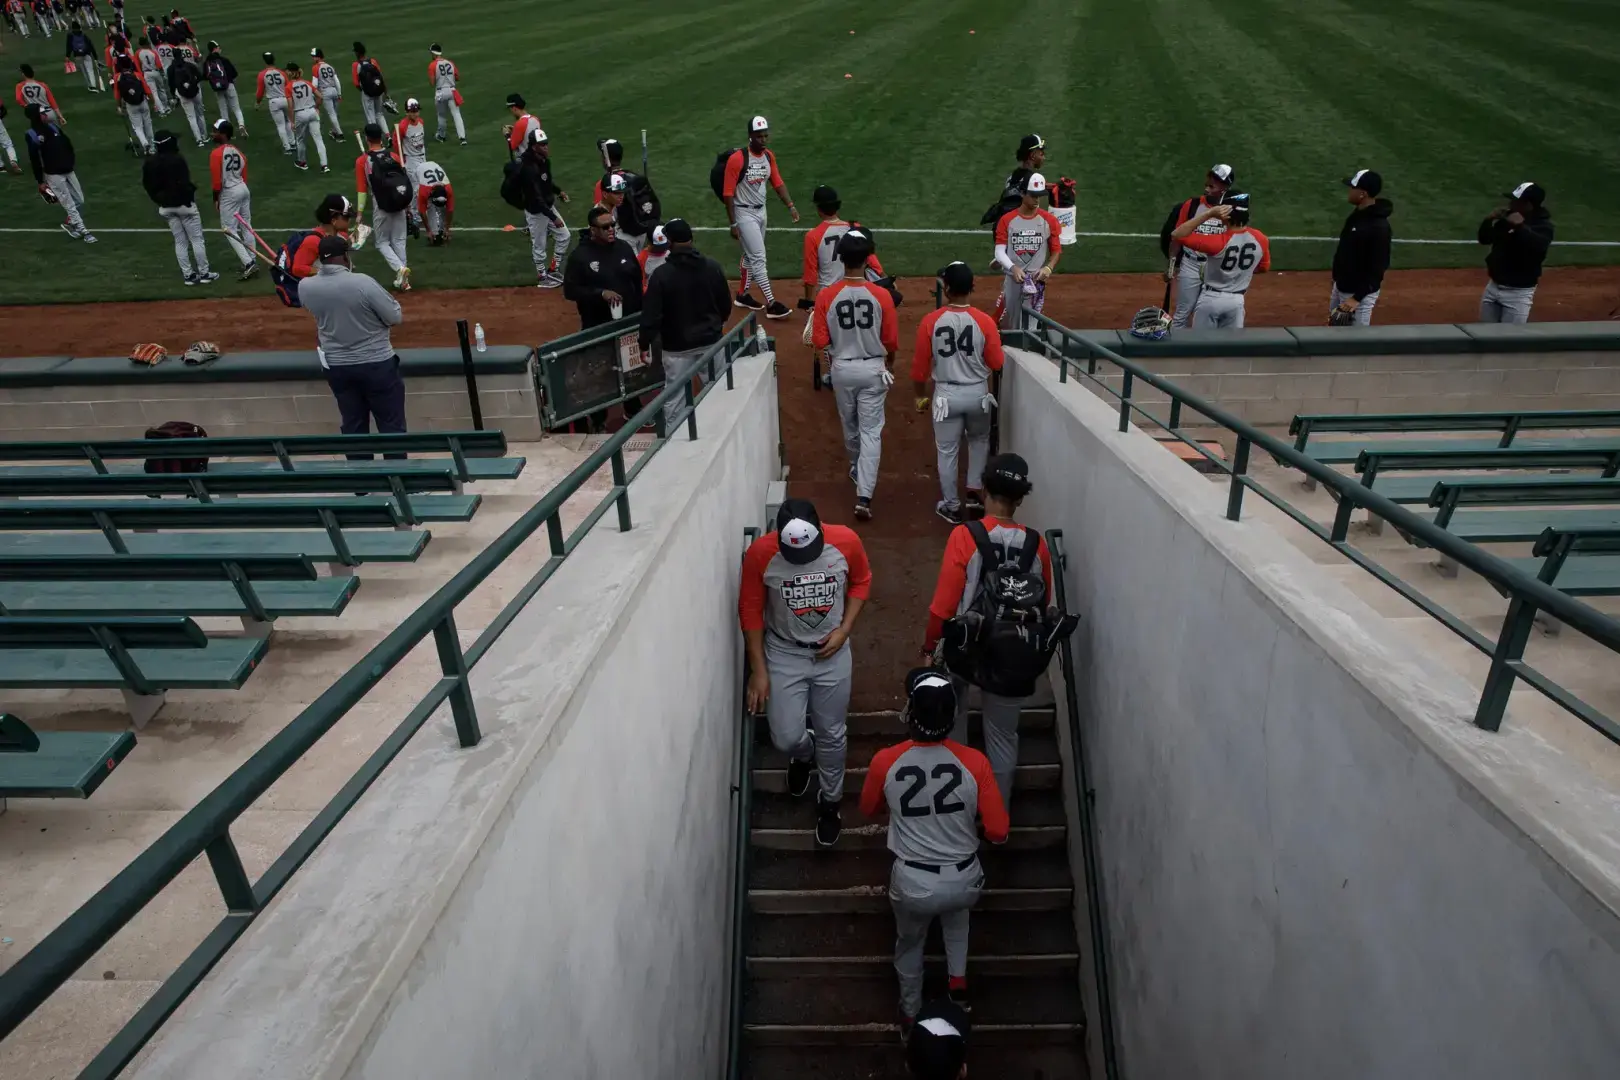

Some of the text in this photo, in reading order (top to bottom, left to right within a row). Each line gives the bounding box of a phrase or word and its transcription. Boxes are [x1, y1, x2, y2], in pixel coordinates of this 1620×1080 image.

[145, 55, 151, 65] 1
[159, 49, 172, 58] 32
[320, 67, 334, 79] 69
[438, 63, 453, 76] 82
[265, 73, 282, 86] 35
[24, 86, 41, 98] 67
[293, 84, 309, 99] 57
[1011, 236, 1043, 244] DREAM
[1221, 242, 1256, 270] 66
[835, 299, 874, 330] 83
[935, 324, 974, 358] 34
[629, 355, 641, 367] ONL
[781, 582, 838, 599] DREAM
[788, 593, 834, 609] SERIES
[895, 763, 965, 817] 22
